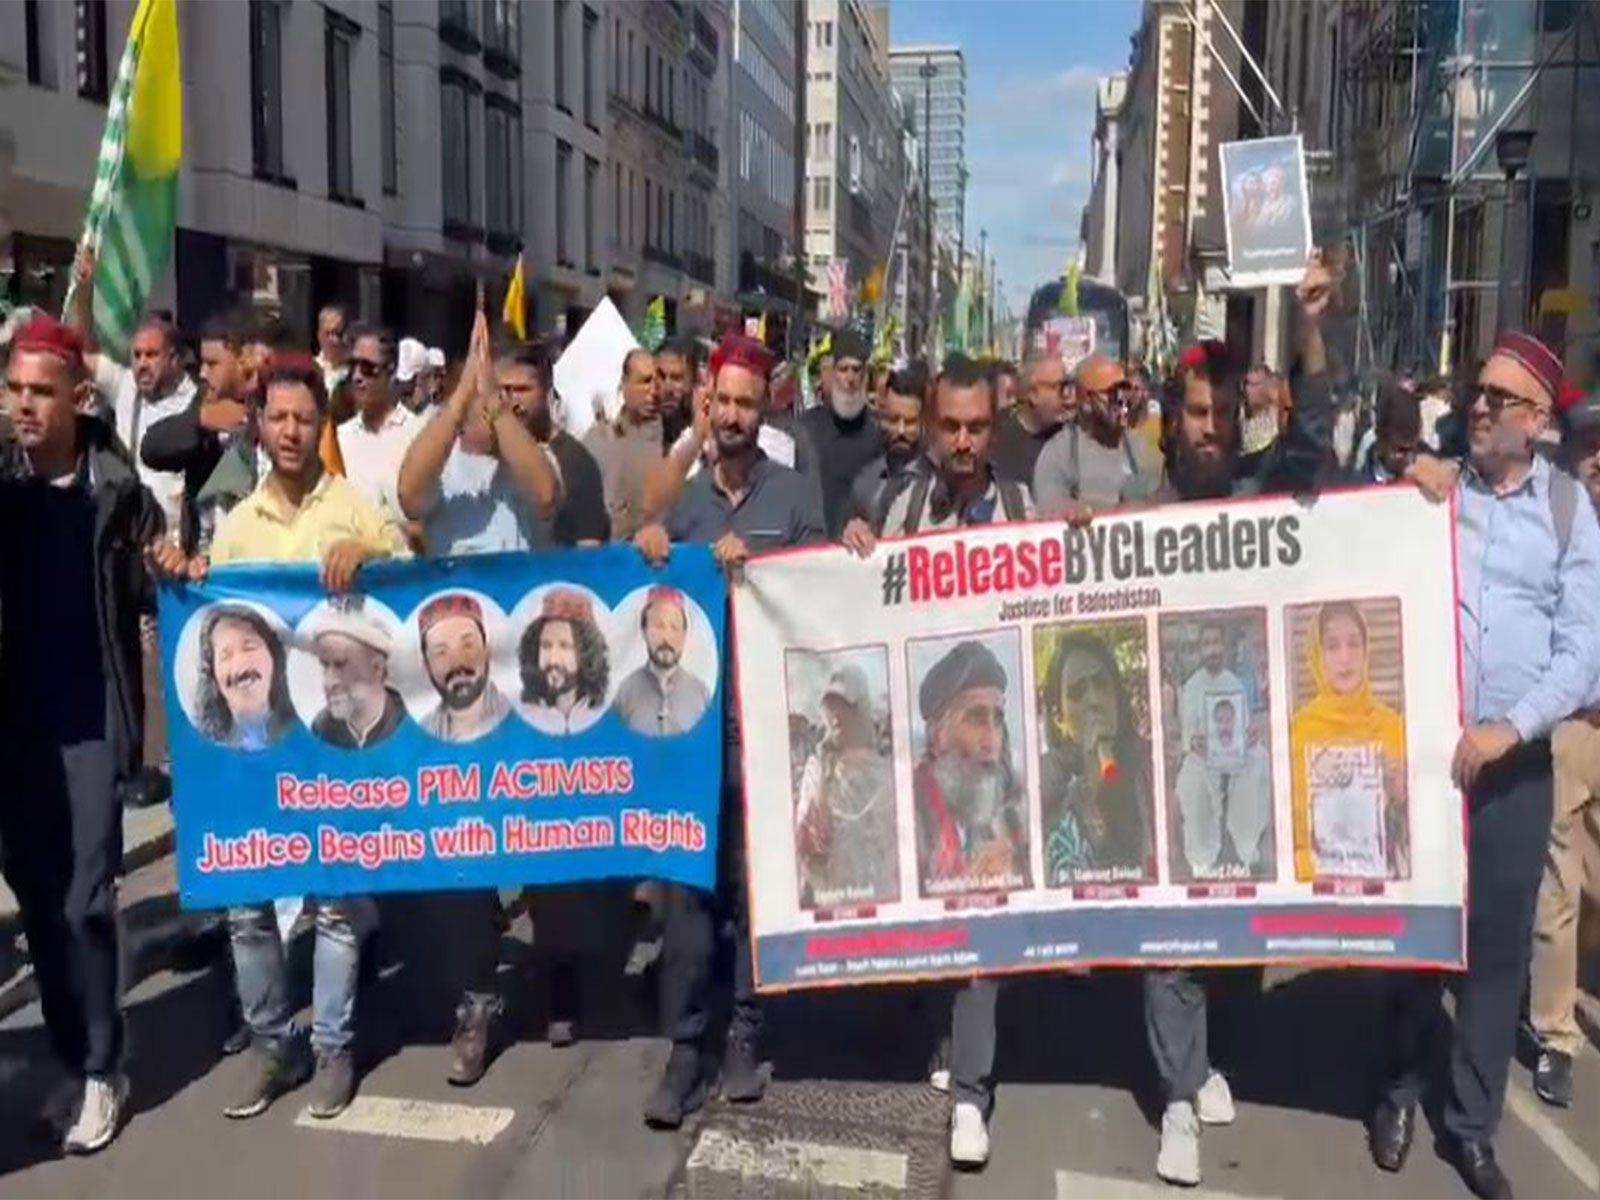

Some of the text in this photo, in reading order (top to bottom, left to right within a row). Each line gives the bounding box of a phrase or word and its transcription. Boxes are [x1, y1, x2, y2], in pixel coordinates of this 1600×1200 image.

[882, 514, 1302, 606] #ReleaseBYCLeaders
[999, 595, 1050, 621] Justice
[1053, 592, 1074, 615] for
[276, 757, 634, 808] Release PTM ACTIVISTS
[197, 808, 706, 872] Justice Begins with Human Rights
